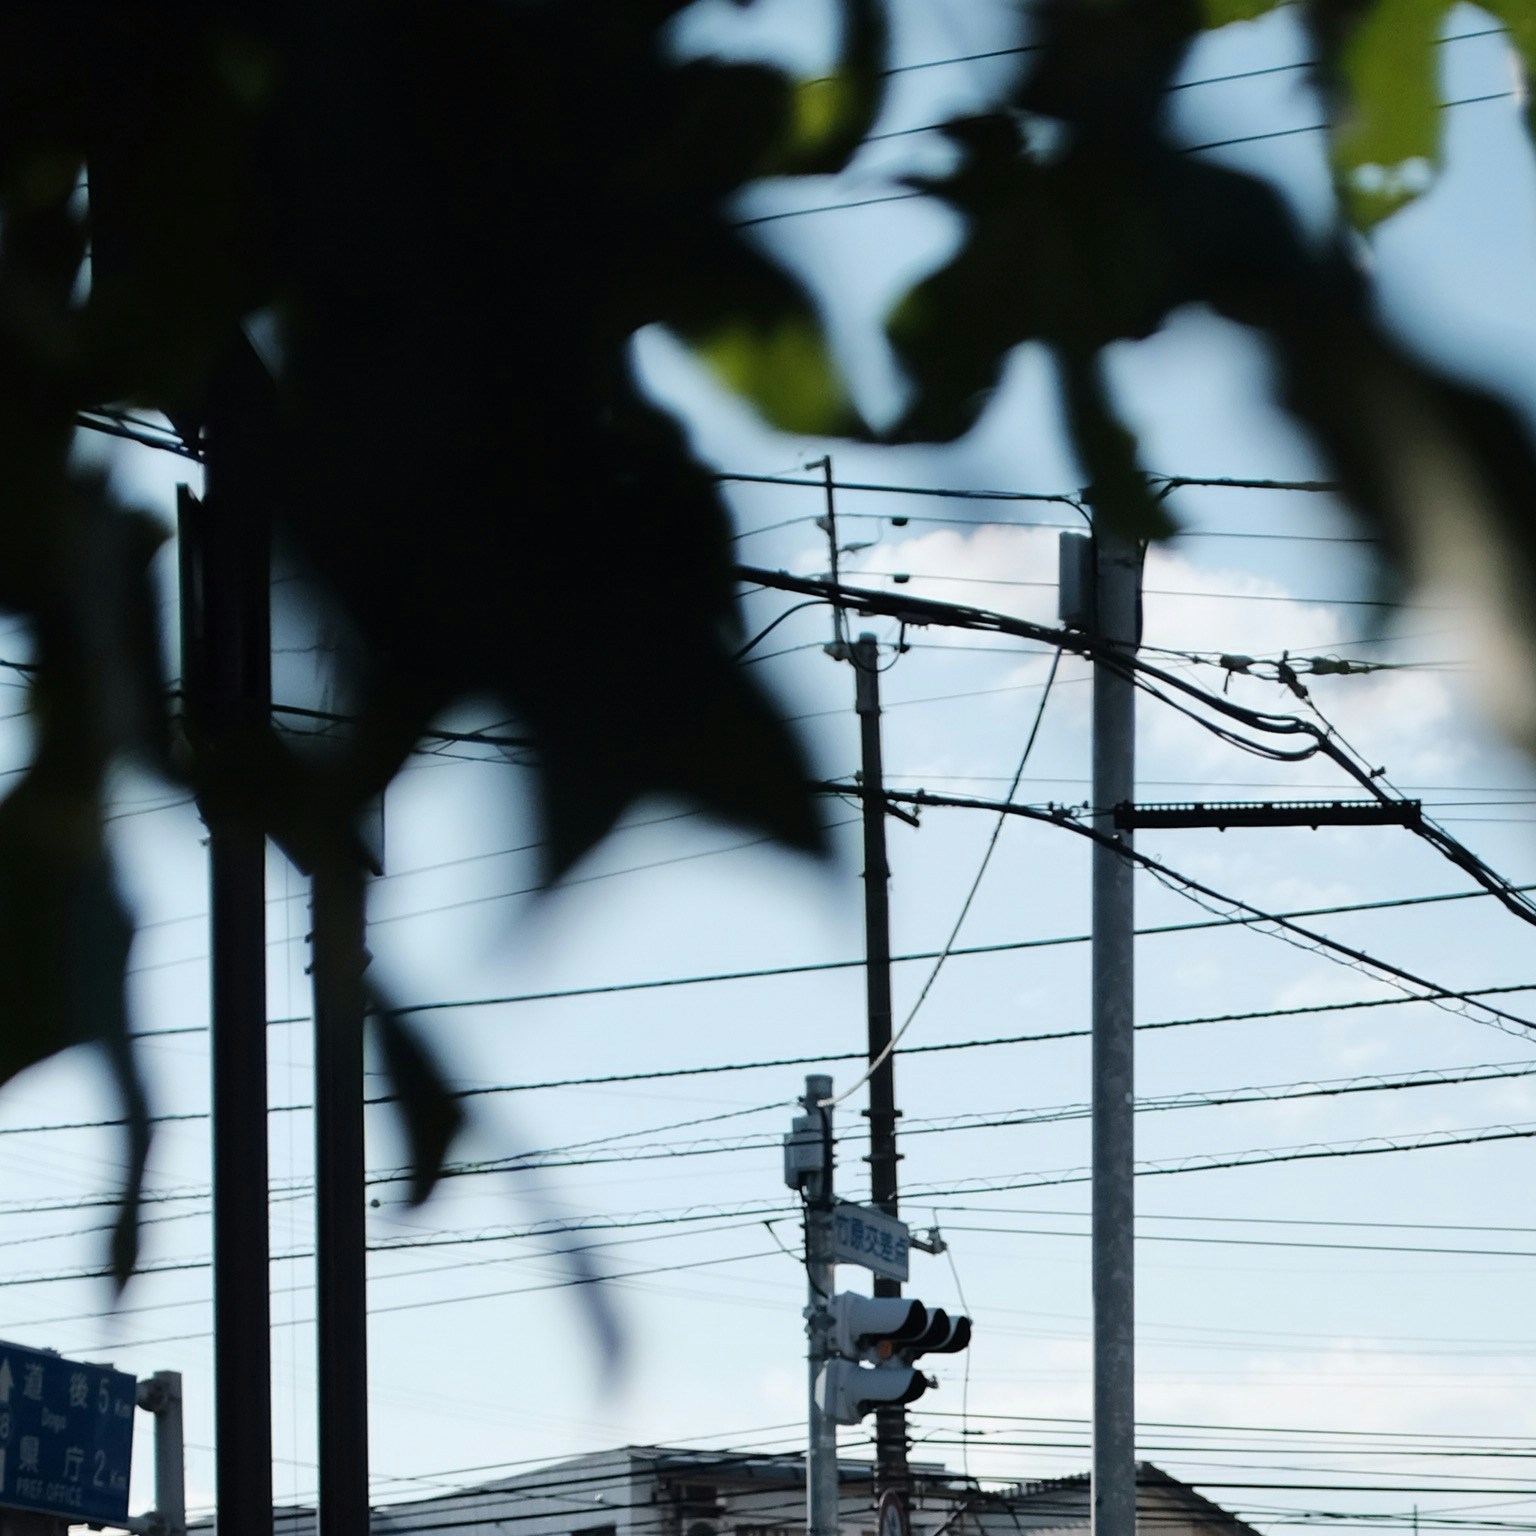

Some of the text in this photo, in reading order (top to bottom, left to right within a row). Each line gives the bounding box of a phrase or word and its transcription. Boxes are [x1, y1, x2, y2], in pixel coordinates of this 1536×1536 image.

[23, 1361, 90, 1409] 道後
[98, 1377, 110, 1415] 5
[18, 1435, 85, 1483] 県庁
[92, 1450, 106, 1487] 2
